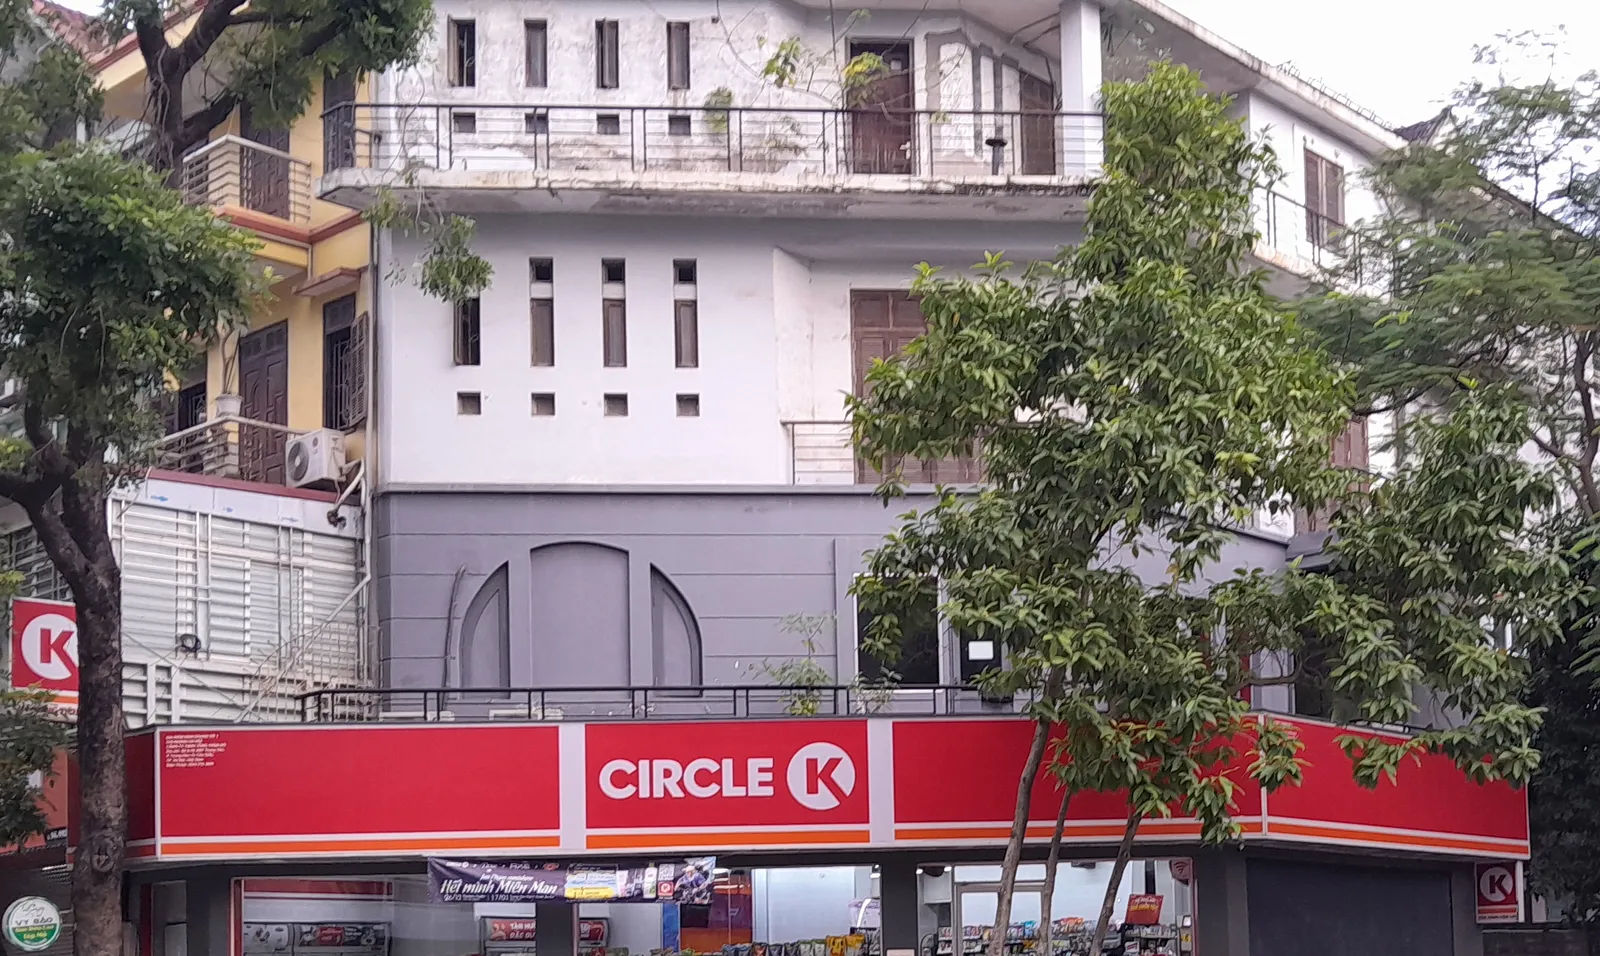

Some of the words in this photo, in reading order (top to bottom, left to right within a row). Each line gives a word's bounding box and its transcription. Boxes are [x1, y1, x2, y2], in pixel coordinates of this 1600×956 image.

[40, 627, 78, 676] K
[598, 757, 775, 799] CIRCLE
[804, 755, 851, 806] K
[1489, 874, 1511, 897] K
